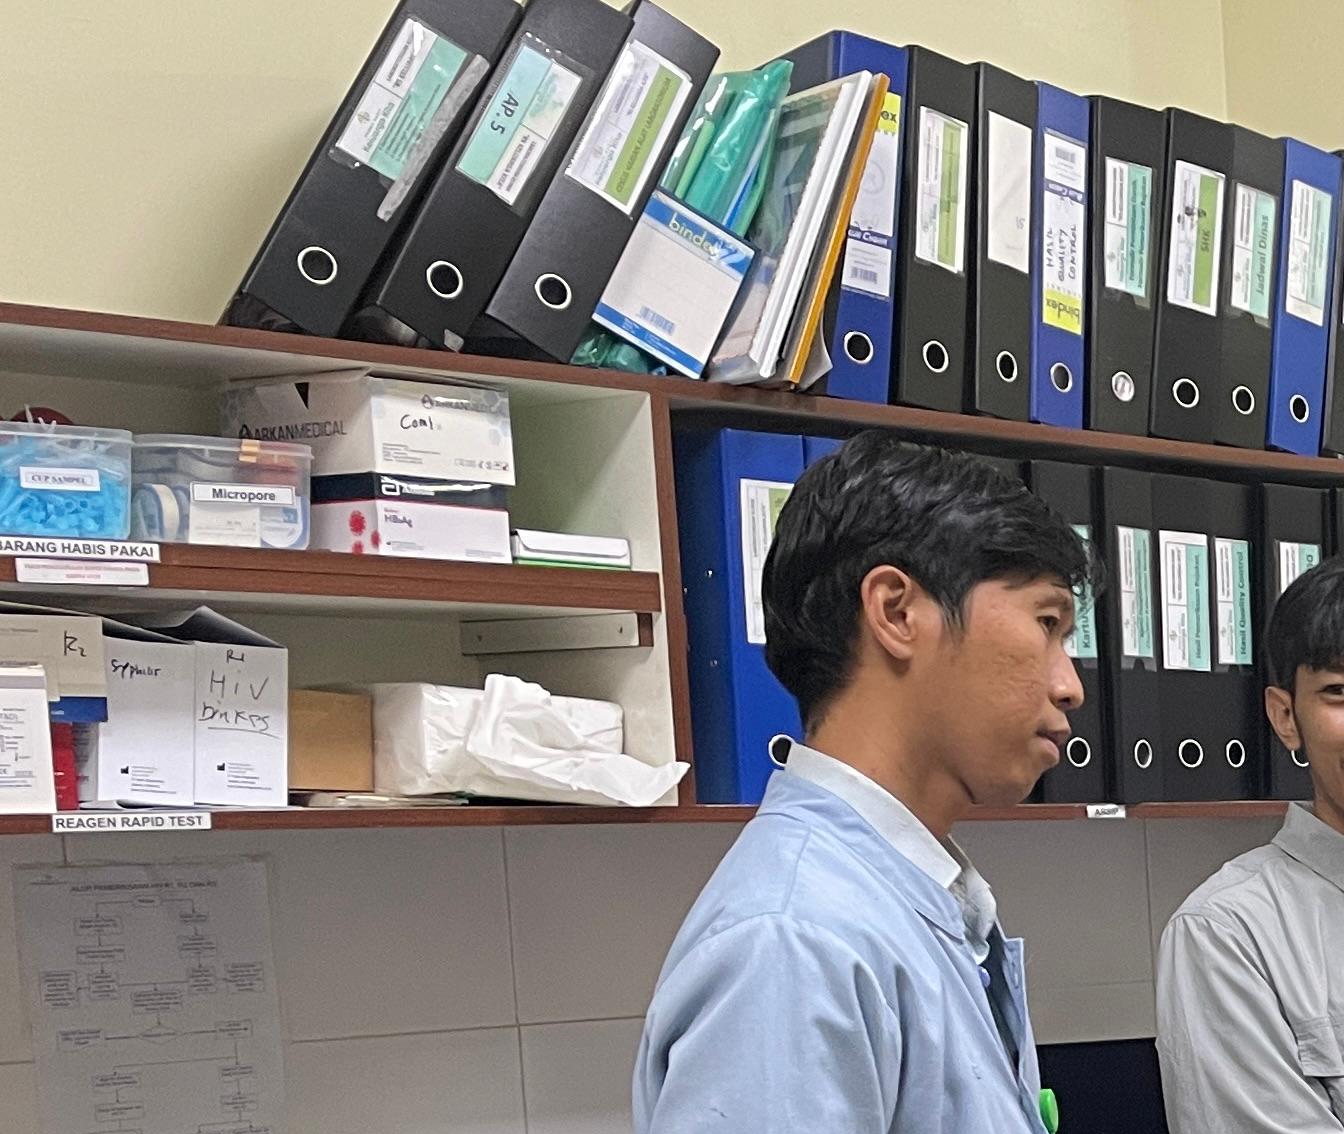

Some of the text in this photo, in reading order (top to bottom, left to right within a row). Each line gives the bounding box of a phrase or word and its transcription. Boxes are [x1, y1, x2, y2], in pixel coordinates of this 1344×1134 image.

[490, 121, 506, 136] 5
[1255, 214, 1269, 296] Jadwal Dinas
[1046, 297, 1080, 324] bindex
[212, 488, 276, 502] Micropore
[61, 541, 106, 555] HABIS
[110, 545, 154, 558] PAKAI
[55, 814, 204, 829] REAGEN RAPID TEST
